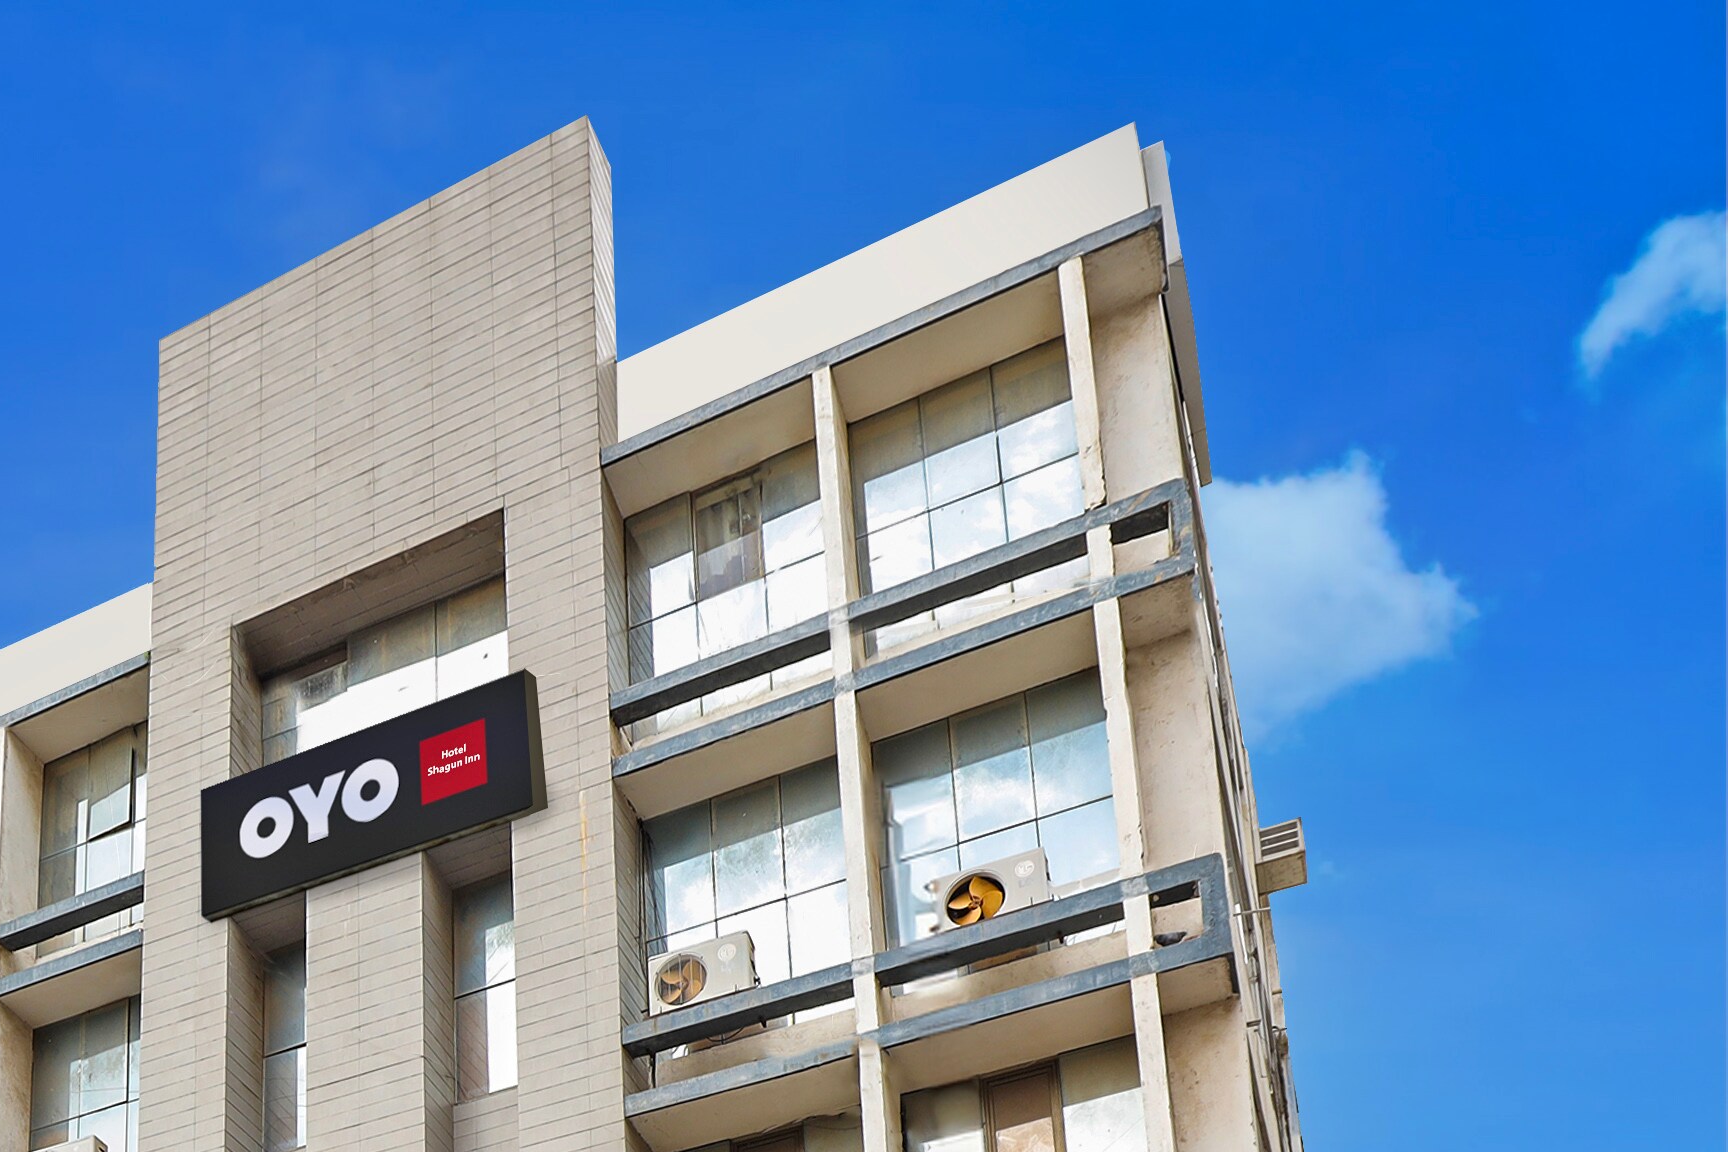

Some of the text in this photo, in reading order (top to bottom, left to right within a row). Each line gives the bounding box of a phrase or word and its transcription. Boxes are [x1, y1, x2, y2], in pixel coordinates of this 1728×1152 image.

[441, 743, 467, 760] Hotel
[427, 753, 481, 777] Shagun Inn
[239, 758, 399, 858] OYO
